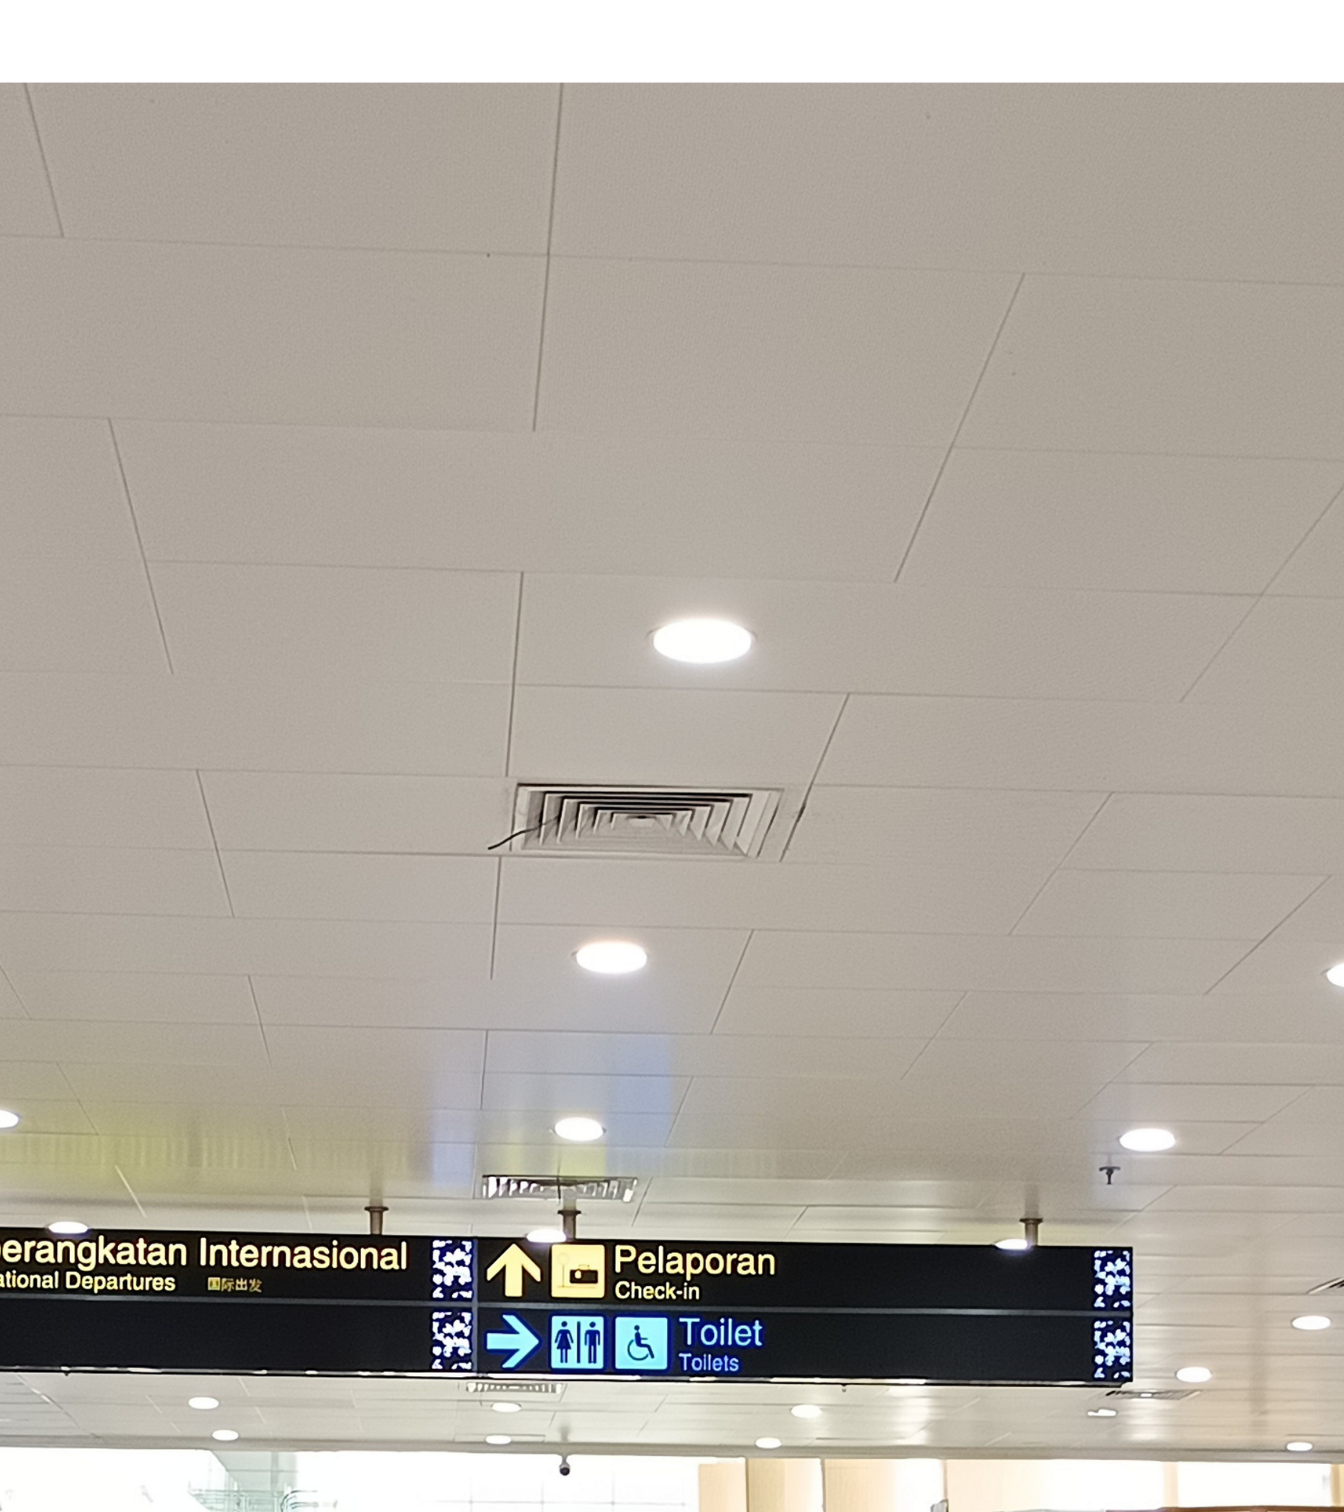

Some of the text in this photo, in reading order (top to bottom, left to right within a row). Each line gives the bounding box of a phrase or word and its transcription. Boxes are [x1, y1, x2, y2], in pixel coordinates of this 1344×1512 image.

[199, 1237, 408, 1271] Internasional
[615, 1244, 776, 1282] Pelaporan
[65, 1271, 176, 1295] Departures
[208, 1277, 262, 1293] 国际出发
[615, 1280, 700, 1300] Check-in
[679, 1317, 763, 1348] Toilet
[679, 1353, 739, 1372] Toilets
